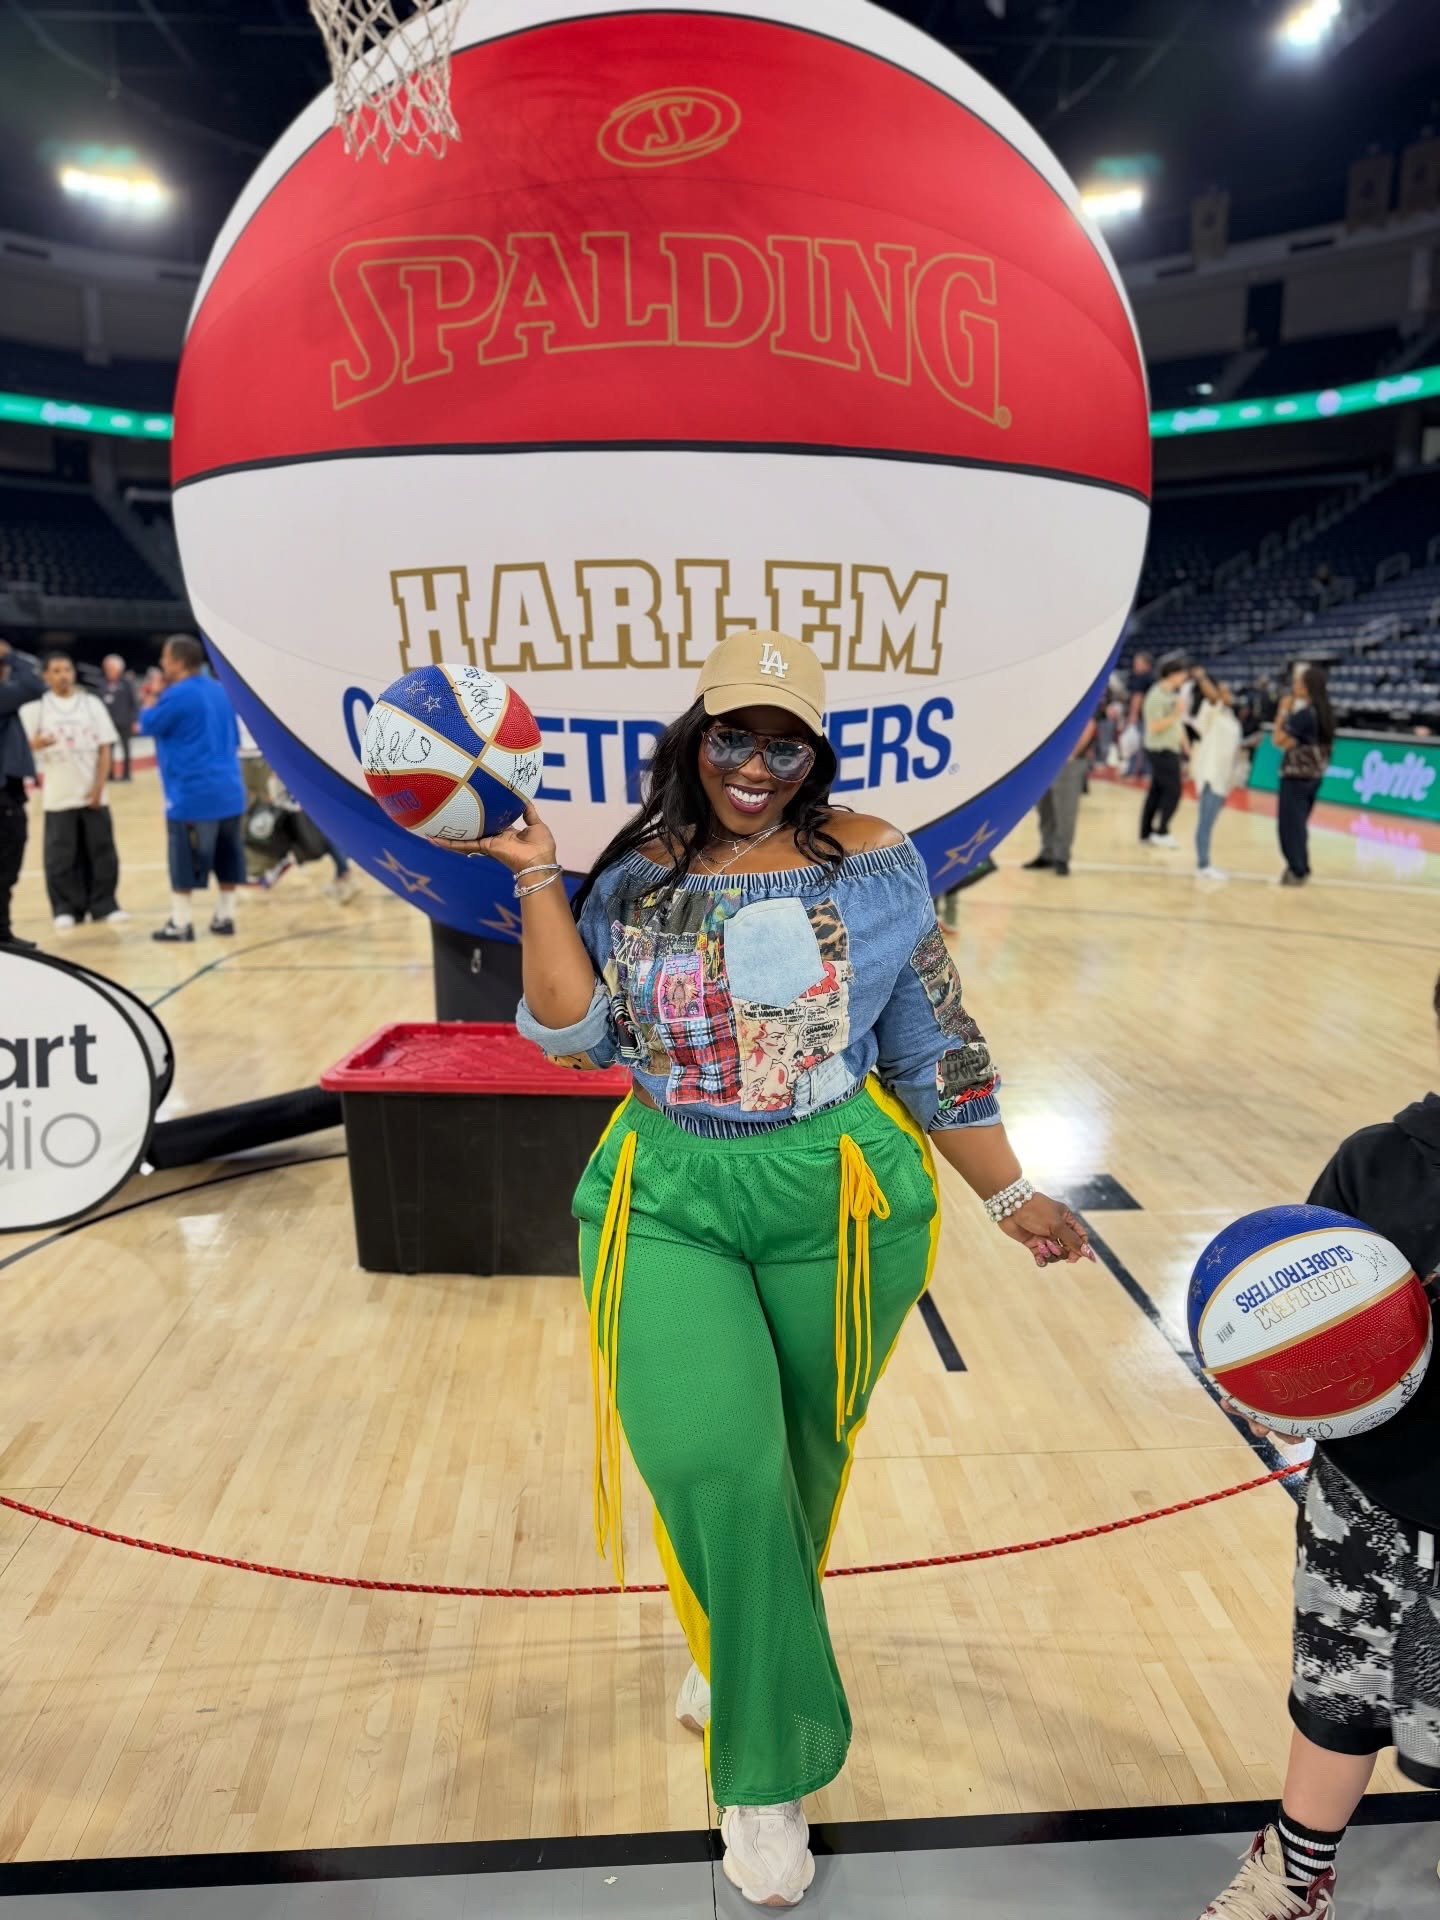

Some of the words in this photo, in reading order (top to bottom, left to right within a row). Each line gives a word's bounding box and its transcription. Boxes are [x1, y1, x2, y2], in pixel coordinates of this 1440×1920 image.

[330, 231, 1004, 427] SPALDING
[389, 558, 949, 676] HARLEM
[759, 643, 789, 679] LA
[1353, 750, 1436, 804] Sprite
[1235, 1245, 1354, 1314] GLOBETROTTERS
[1254, 1265, 1358, 1331] HARLEM
